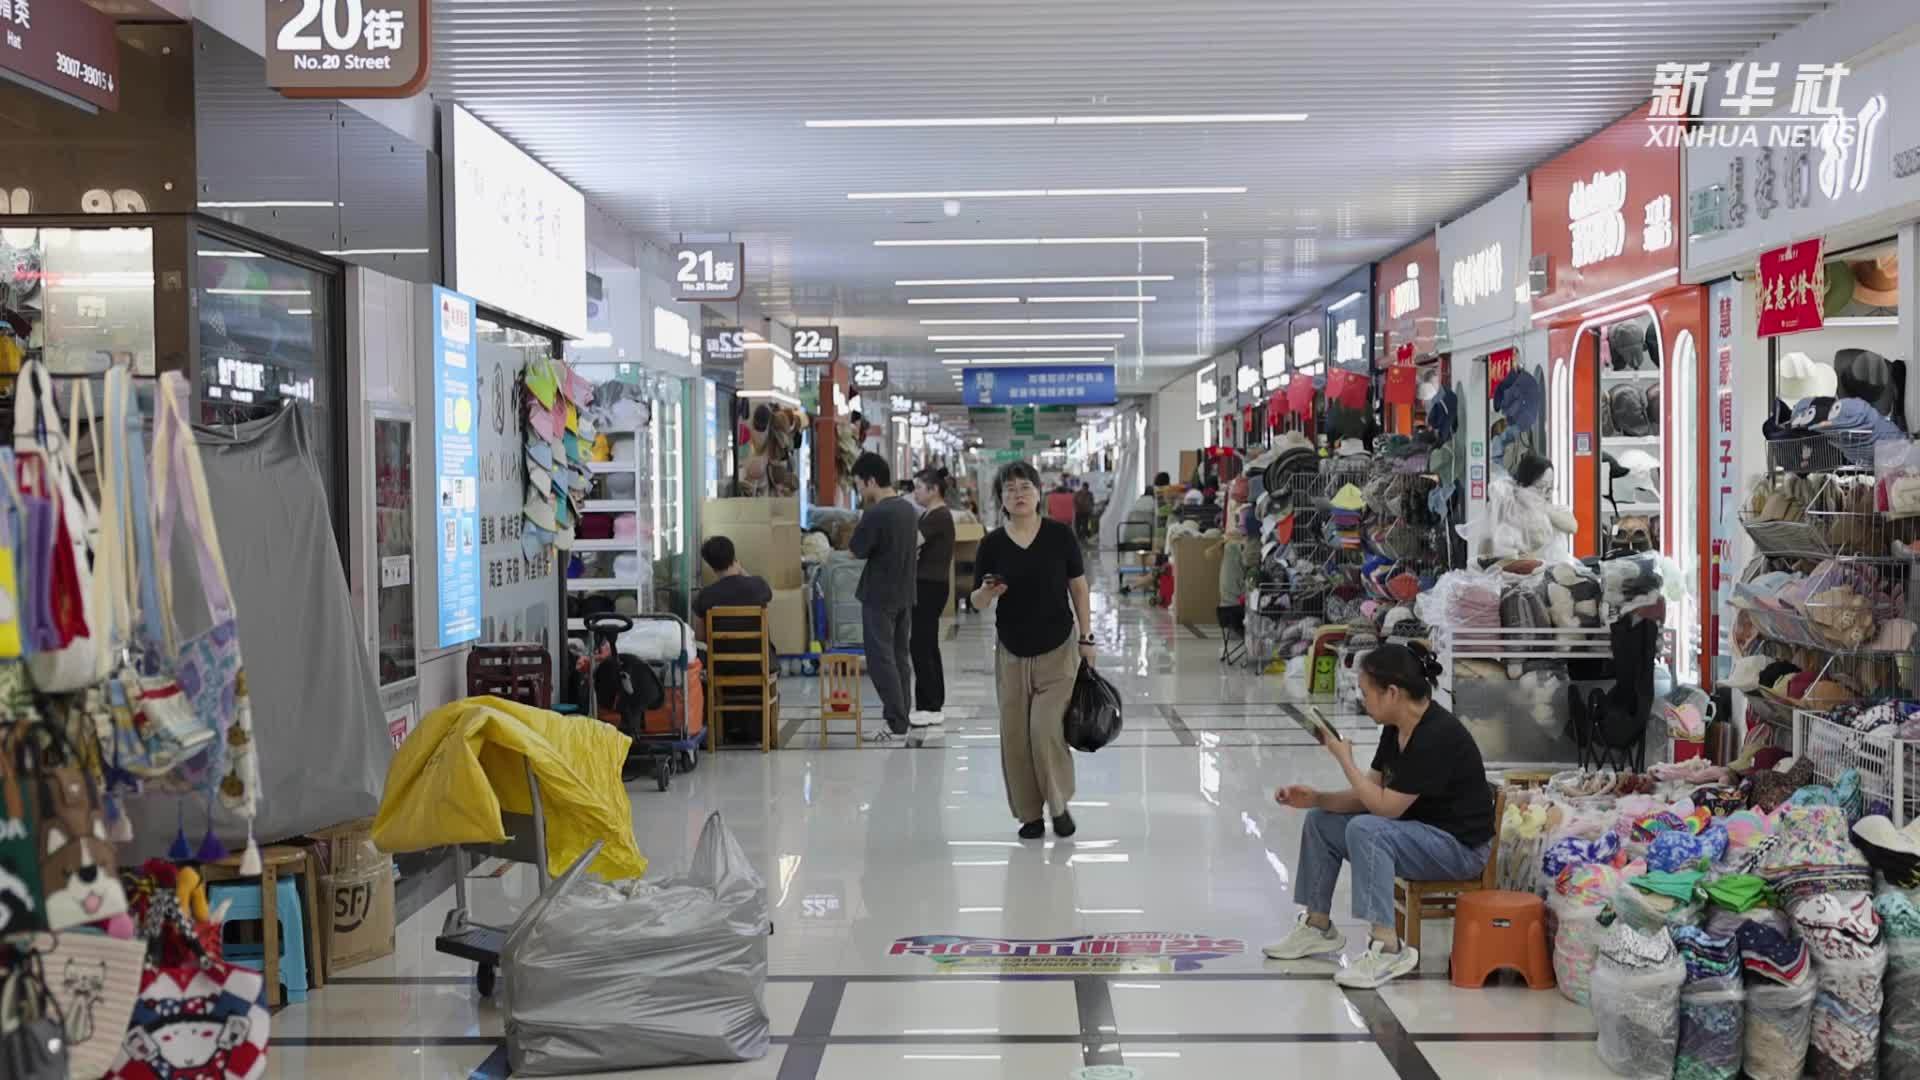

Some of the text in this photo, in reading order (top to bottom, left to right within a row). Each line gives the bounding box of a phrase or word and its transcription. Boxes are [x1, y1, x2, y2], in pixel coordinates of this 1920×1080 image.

[7, 30, 22, 50] Hat
[277, 0, 404, 50] 20街
[294, 54, 391, 69] No.20 Street
[677, 250, 734, 282] 21街
[334, 885, 365, 917] SF
